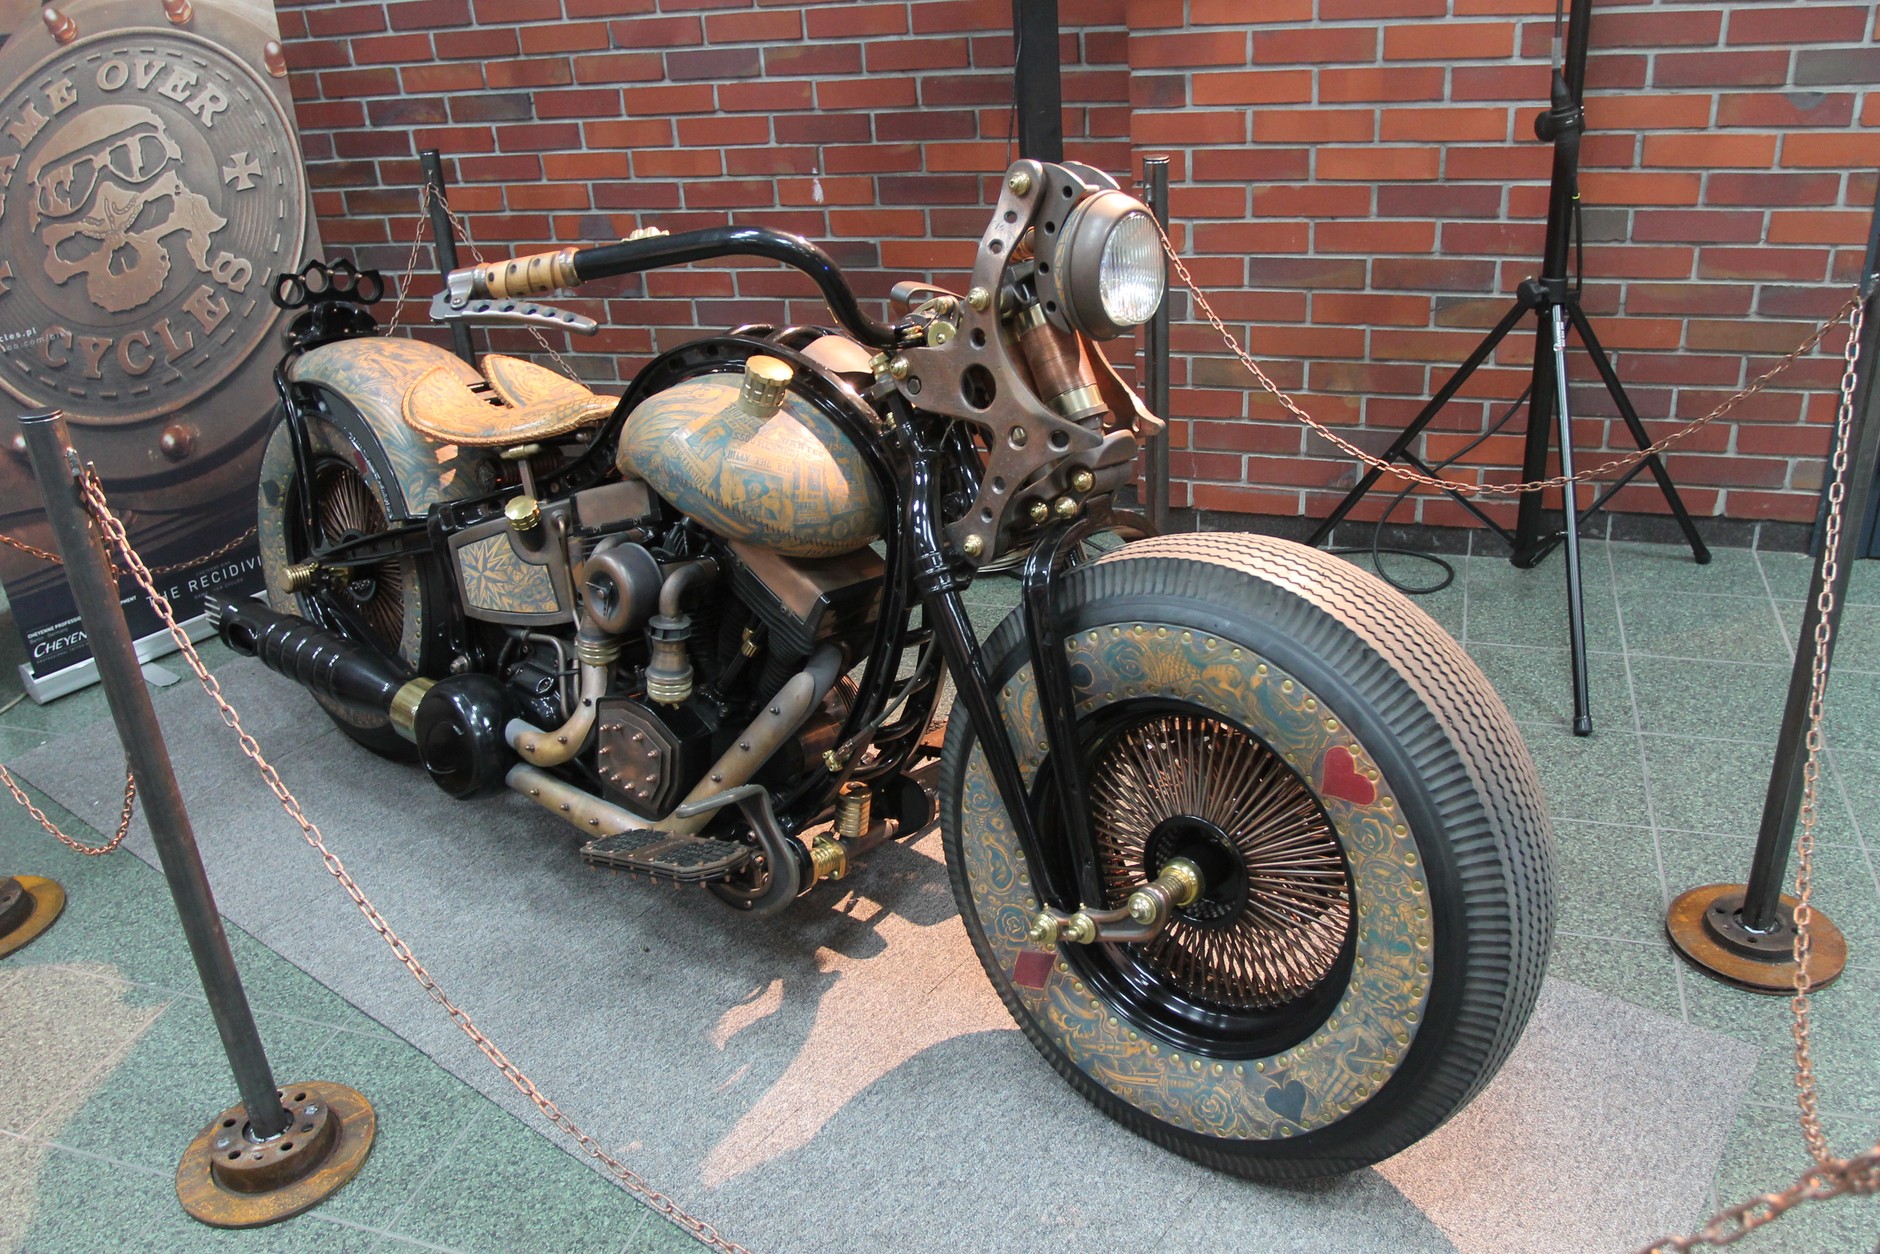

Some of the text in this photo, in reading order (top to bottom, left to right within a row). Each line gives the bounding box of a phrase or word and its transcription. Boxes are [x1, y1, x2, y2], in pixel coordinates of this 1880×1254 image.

[0, 59, 229, 217] AME OVER
[38, 252, 253, 380] CYCLES
